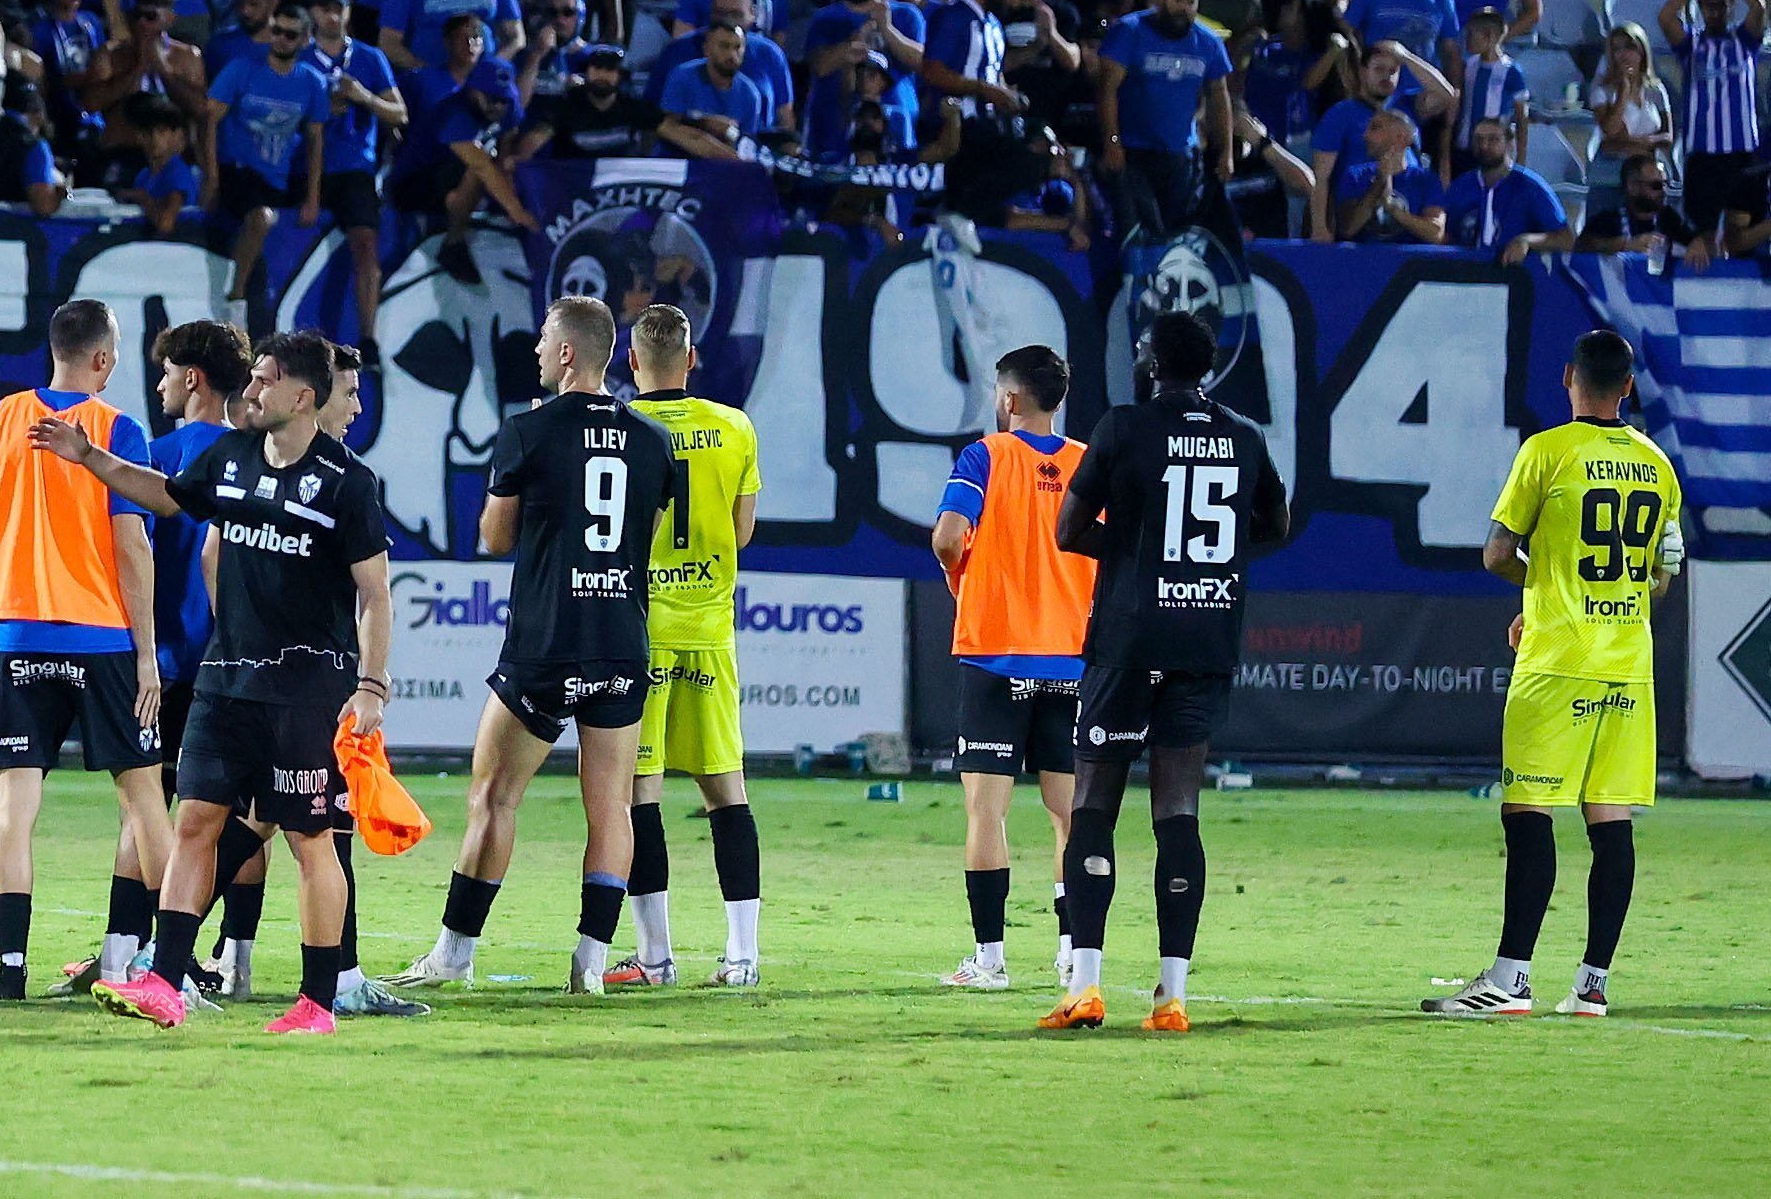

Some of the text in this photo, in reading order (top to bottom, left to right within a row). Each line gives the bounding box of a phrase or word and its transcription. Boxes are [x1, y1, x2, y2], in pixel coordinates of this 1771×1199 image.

[584, 428, 628, 451] ILIEV
[1167, 436, 1235, 459] MUGABI
[1585, 461, 1658, 484] KERAVNOS
[584, 456, 628, 552] 9
[1161, 465, 1239, 564] 15
[1578, 488, 1662, 582] 99
[572, 567, 632, 591] IronFX
[1158, 573, 1238, 601] IronFX
[735, 585, 864, 633] louros
[1158, 600, 1232, 609] SOLID TRADING
[9, 659, 86, 679] Singular
[1311, 663, 1486, 694] DAY-TO-NIGHT
[296, 767, 329, 795] GROUP
